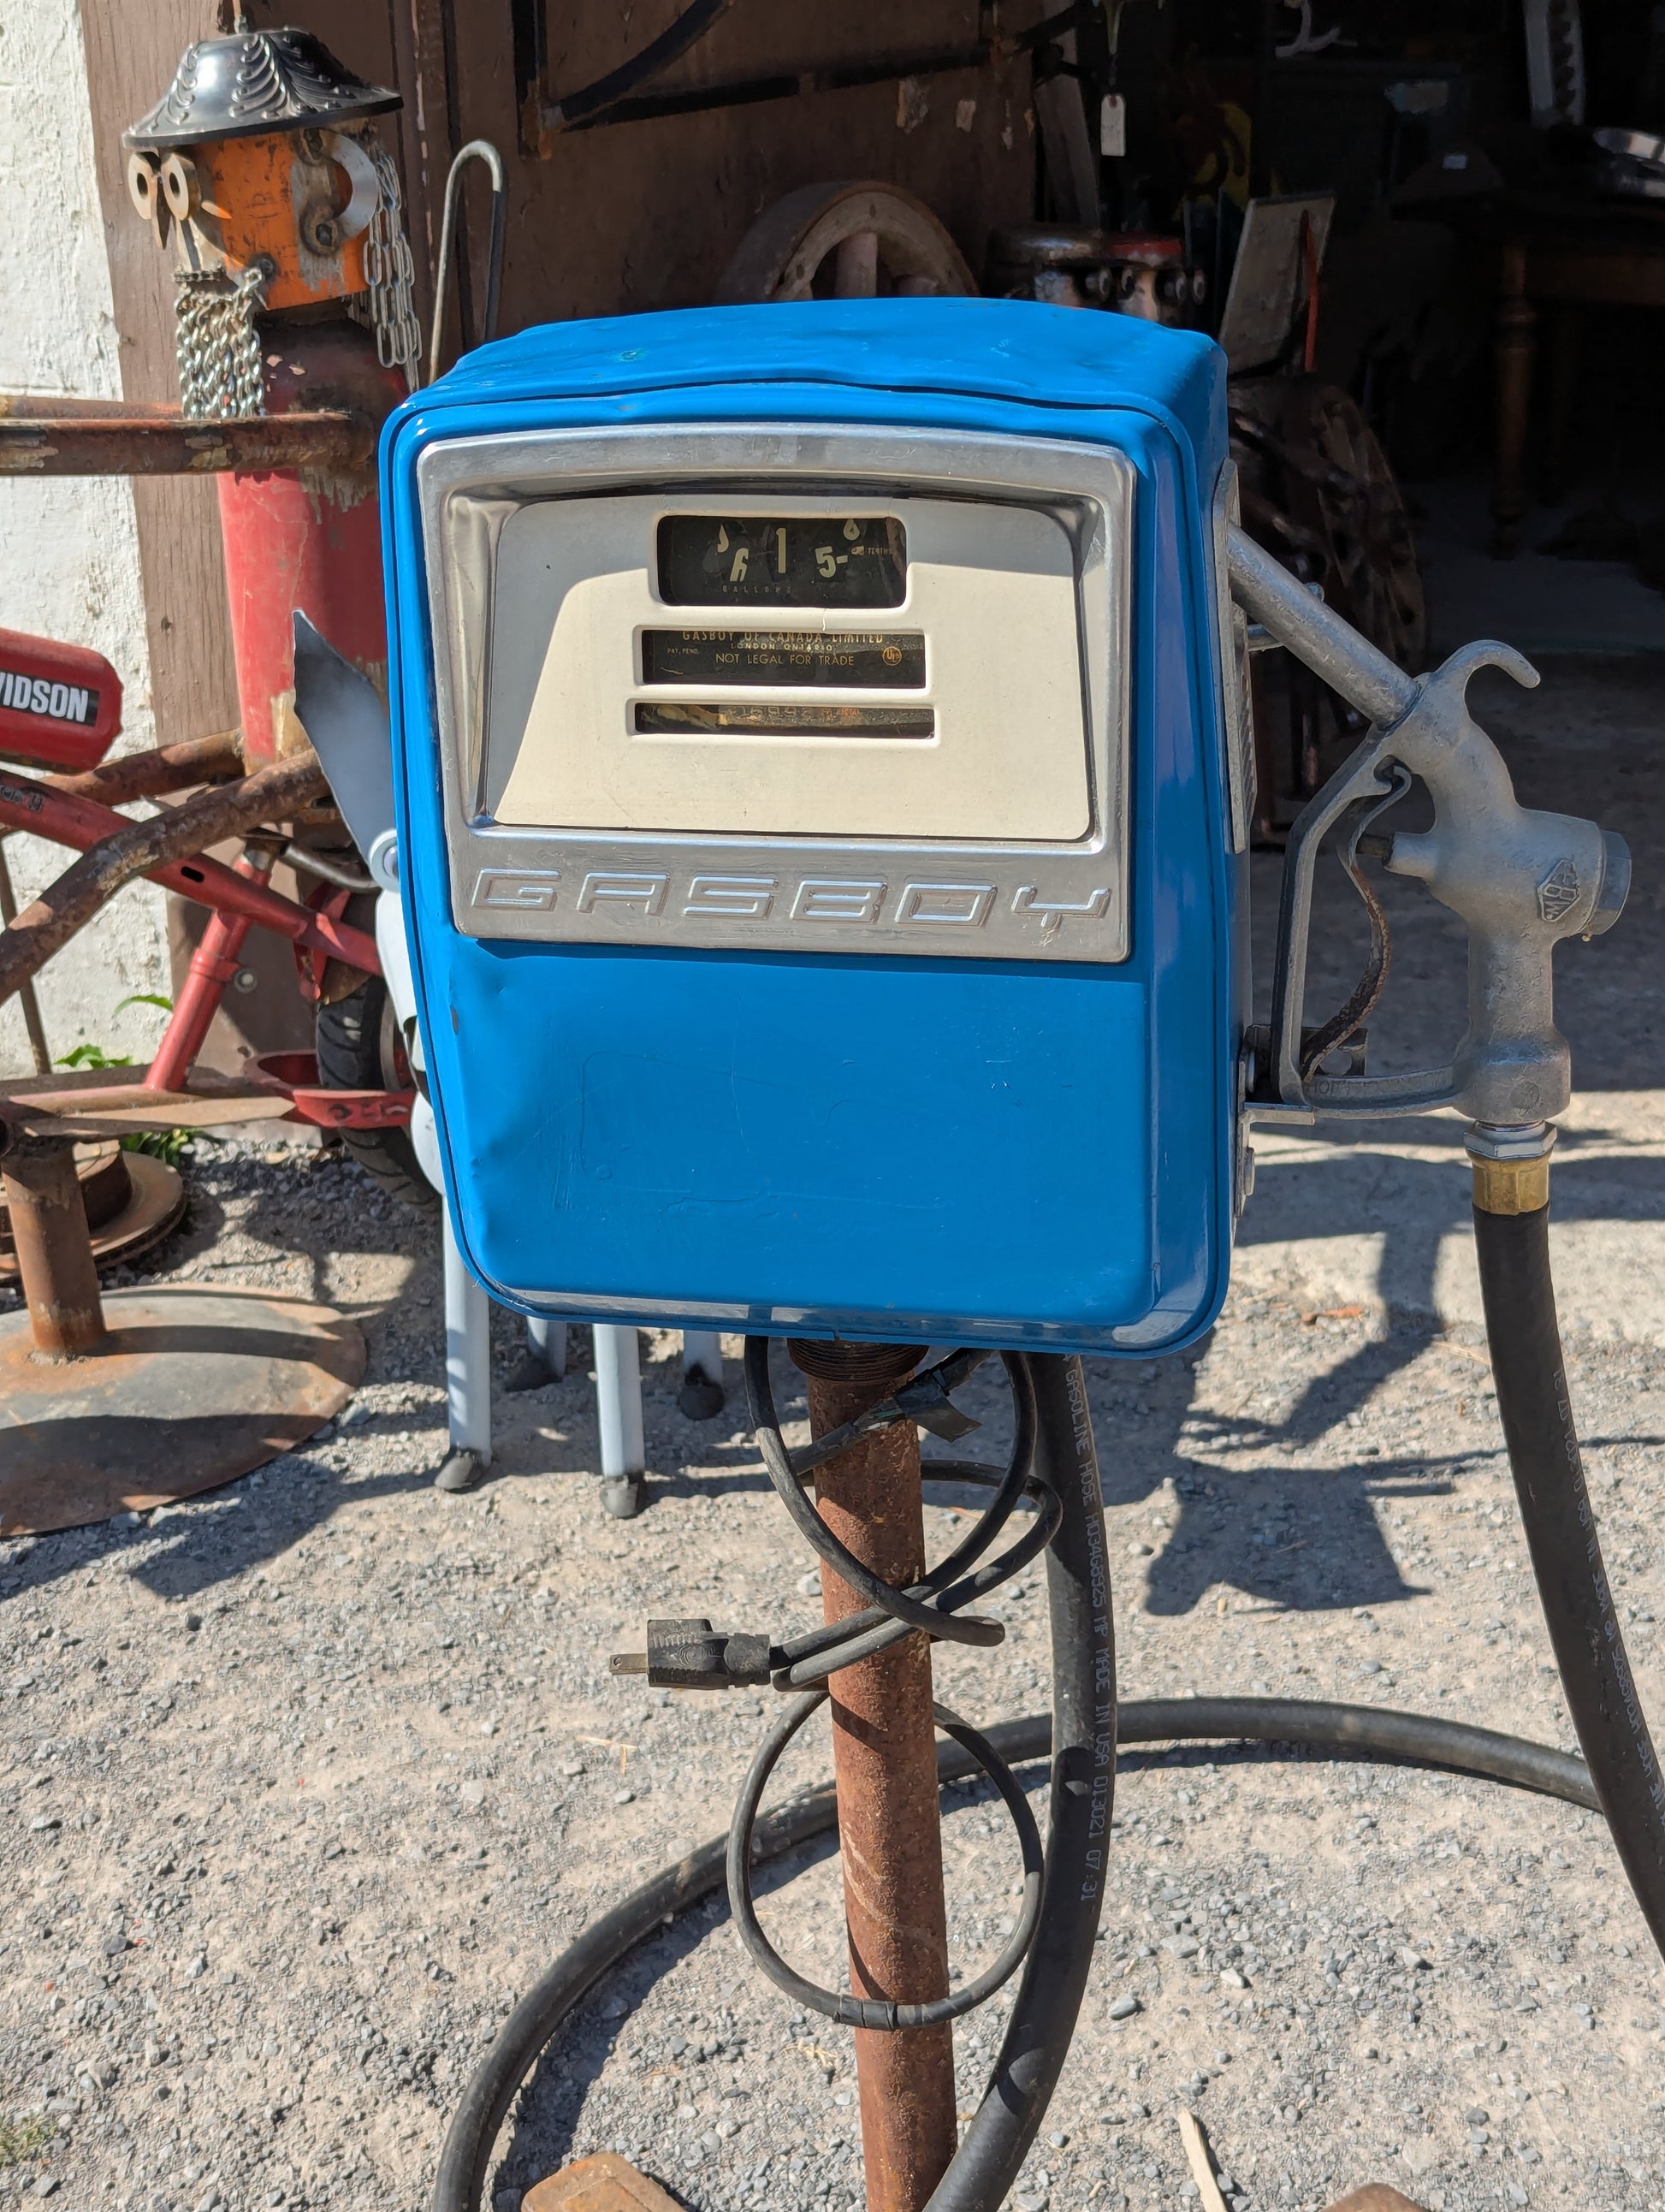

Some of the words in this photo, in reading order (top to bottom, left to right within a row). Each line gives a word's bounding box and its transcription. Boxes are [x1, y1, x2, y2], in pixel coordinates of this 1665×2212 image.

[732, 642, 775, 650] LONDON
[784, 643, 833, 652] ONTARIO
[769, 633, 822, 643] CANADA
[832, 634, 883, 644] LIMITED
[715, 653, 740, 665] NOT
[747, 654, 783, 665] LEGAL
[790, 655, 812, 666] FOR
[819, 655, 855, 667] TRADE
[471, 868, 1111, 931] GASBOY
[1064, 1369, 1090, 1456] GASOLINE
[1078, 1462, 1097, 1507] HOSE
[1094, 1646, 1111, 1693] MADE
[1095, 1703, 1111, 1725] IN
[1094, 1731, 1111, 1767] USA
[1087, 1775, 1108, 1839] 013021
